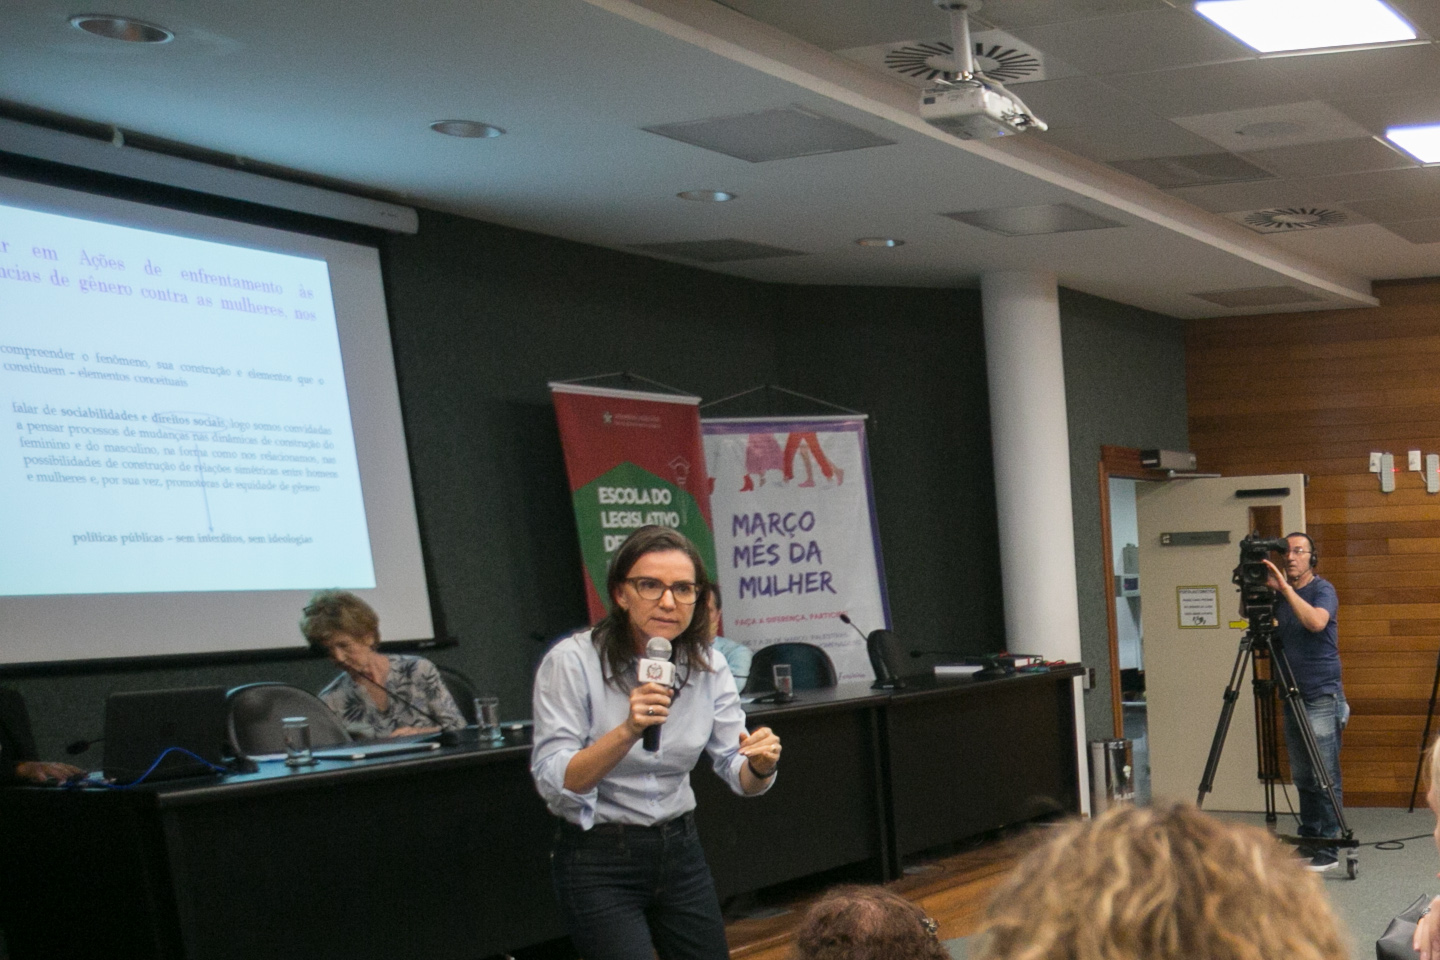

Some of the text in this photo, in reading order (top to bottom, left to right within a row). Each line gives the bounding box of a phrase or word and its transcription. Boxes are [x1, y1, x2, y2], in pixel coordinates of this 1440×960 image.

[32, 245, 59, 261] em
[79, 248, 126, 271] Ações
[144, 258, 163, 277] de
[180, 267, 283, 295] enfrentamento
[298, 283, 314, 299] às
[0, 264, 317, 322] ncias de gênero contra as mulheres, nos
[0, 344, 75, 360] compreender
[81, 353, 90, 362] o
[96, 352, 151, 369] fenômeno,
[156, 360, 174, 371] sua
[180, 362, 231, 378] construção
[248, 368, 293, 383] elementos
[297, 375, 314, 387] que
[3, 362, 66, 377] constituem
[78, 367, 131, 382] elementos
[12, 401, 38, 415] falar
[42, 403, 58, 416] de
[61, 404, 139, 422] sociabilidades
[151, 412, 191, 426] direitos
[230, 418, 251, 433] logo
[253, 421, 282, 432] somos
[20, 436, 70, 450] feminino
[86, 440, 99, 451] do
[104, 442, 160, 456] masculino,
[163, 446, 176, 456] na
[212, 450, 238, 460] como
[241, 451, 257, 460] nos
[27, 422, 64, 435] pensar
[68, 424, 120, 437] processos
[123, 426, 136, 437] de
[139, 429, 190, 442] mudanças
[192, 430, 209, 442] nas
[212, 430, 259, 445] dinâmicas
[261, 436, 273, 446] de
[274, 437, 321, 450] construção
[323, 438, 335, 449] do
[23, 454, 102, 468] possibilidades
[106, 458, 118, 469] de
[122, 460, 177, 473] construção
[179, 461, 192, 472] de
[36, 471, 86, 483] mulheres
[102, 475, 120, 488] por
[122, 477, 140, 486] sua
[222, 478, 234, 489] de
[280, 480, 290, 491] de
[598, 486, 672, 505] ESCOLA DO
[601, 511, 681, 528] LEGISLATIVO
[731, 511, 816, 539] MARÇO
[72, 530, 119, 546] políticas
[121, 531, 165, 546] públicas
[175, 534, 195, 544] sem
[248, 534, 266, 544] sem
[732, 537, 823, 569] MÊS DA
[738, 570, 838, 600] MULHER
